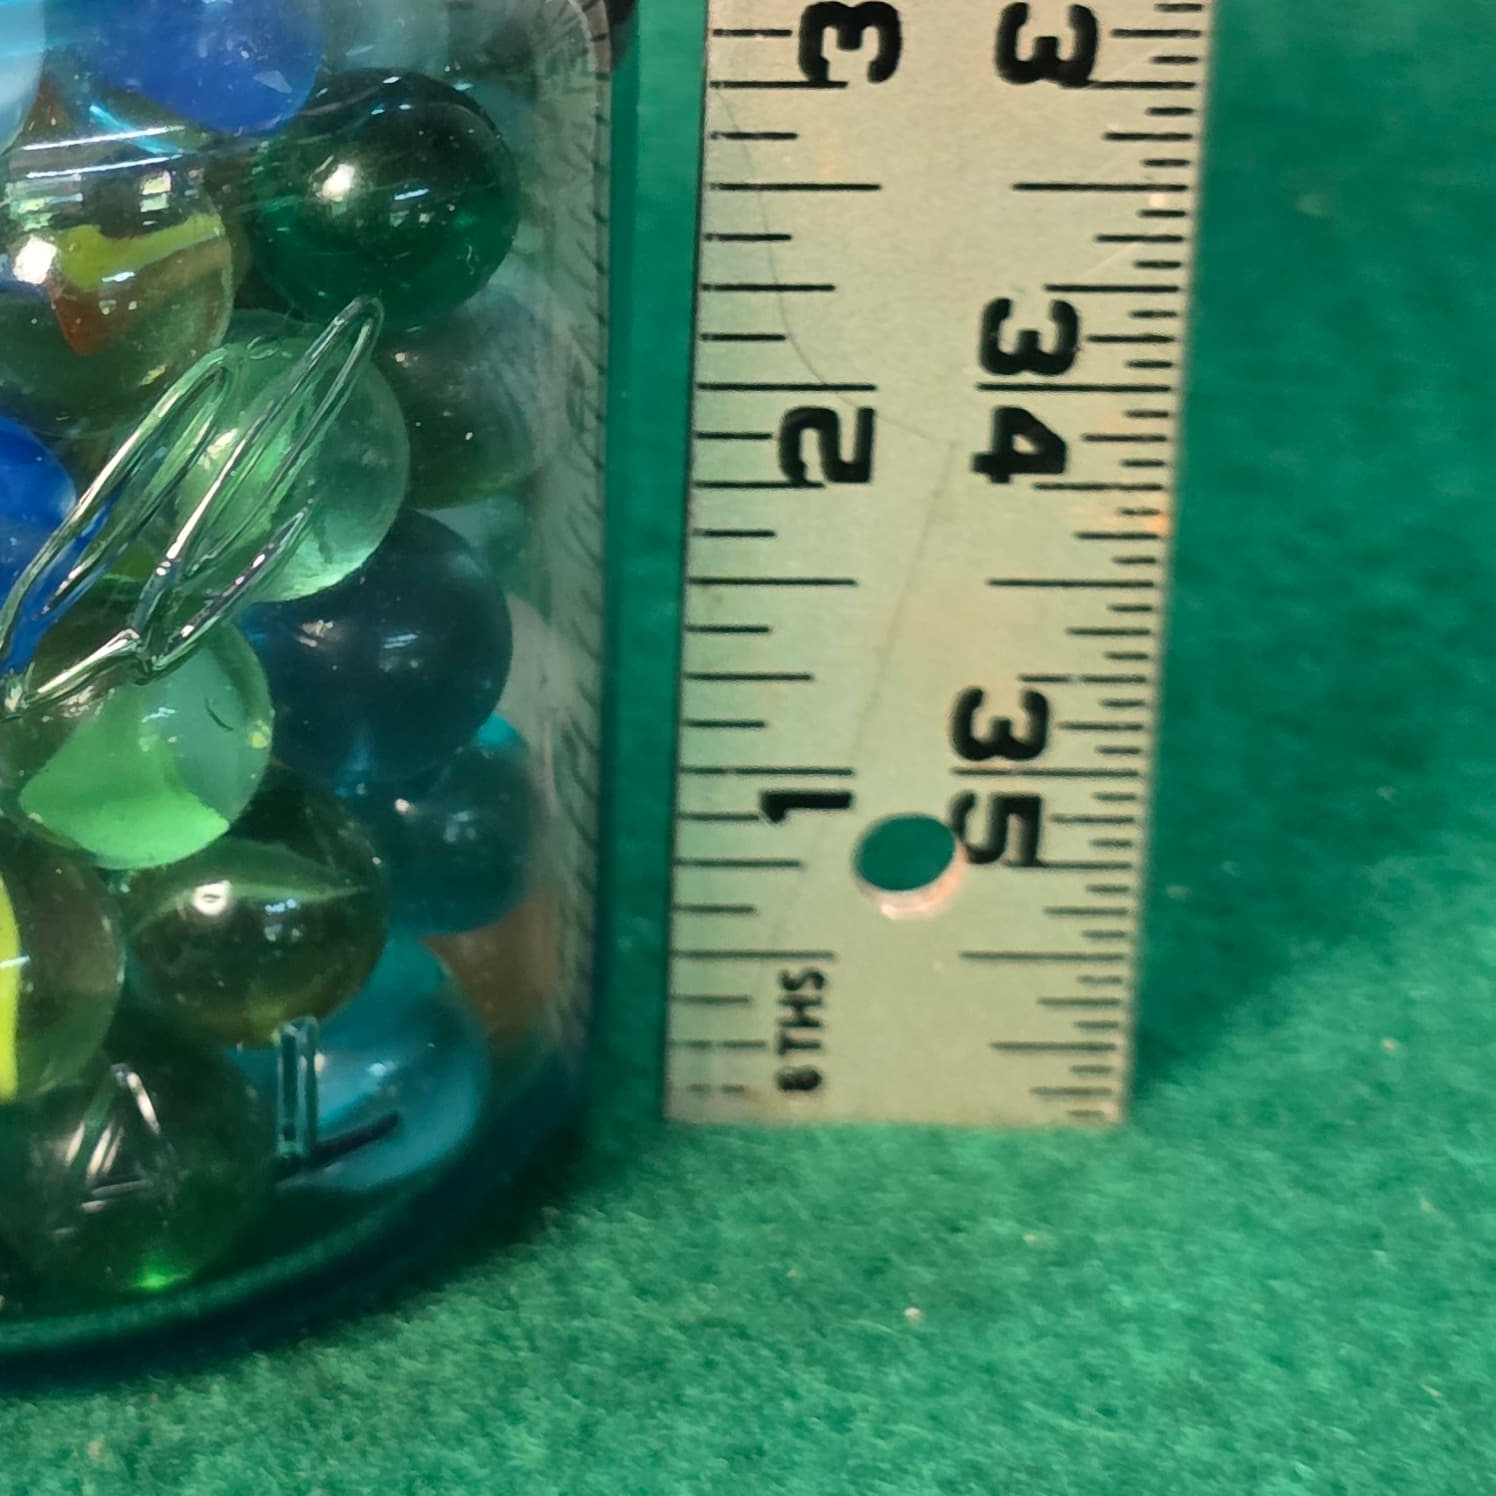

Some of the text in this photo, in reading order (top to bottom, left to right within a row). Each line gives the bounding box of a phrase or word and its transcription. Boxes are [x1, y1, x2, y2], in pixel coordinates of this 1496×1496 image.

[797, 0, 903, 86] 3
[971, 297, 1081, 486] 34
[776, 405, 876, 485] 2
[758, 789, 855, 826] 1
